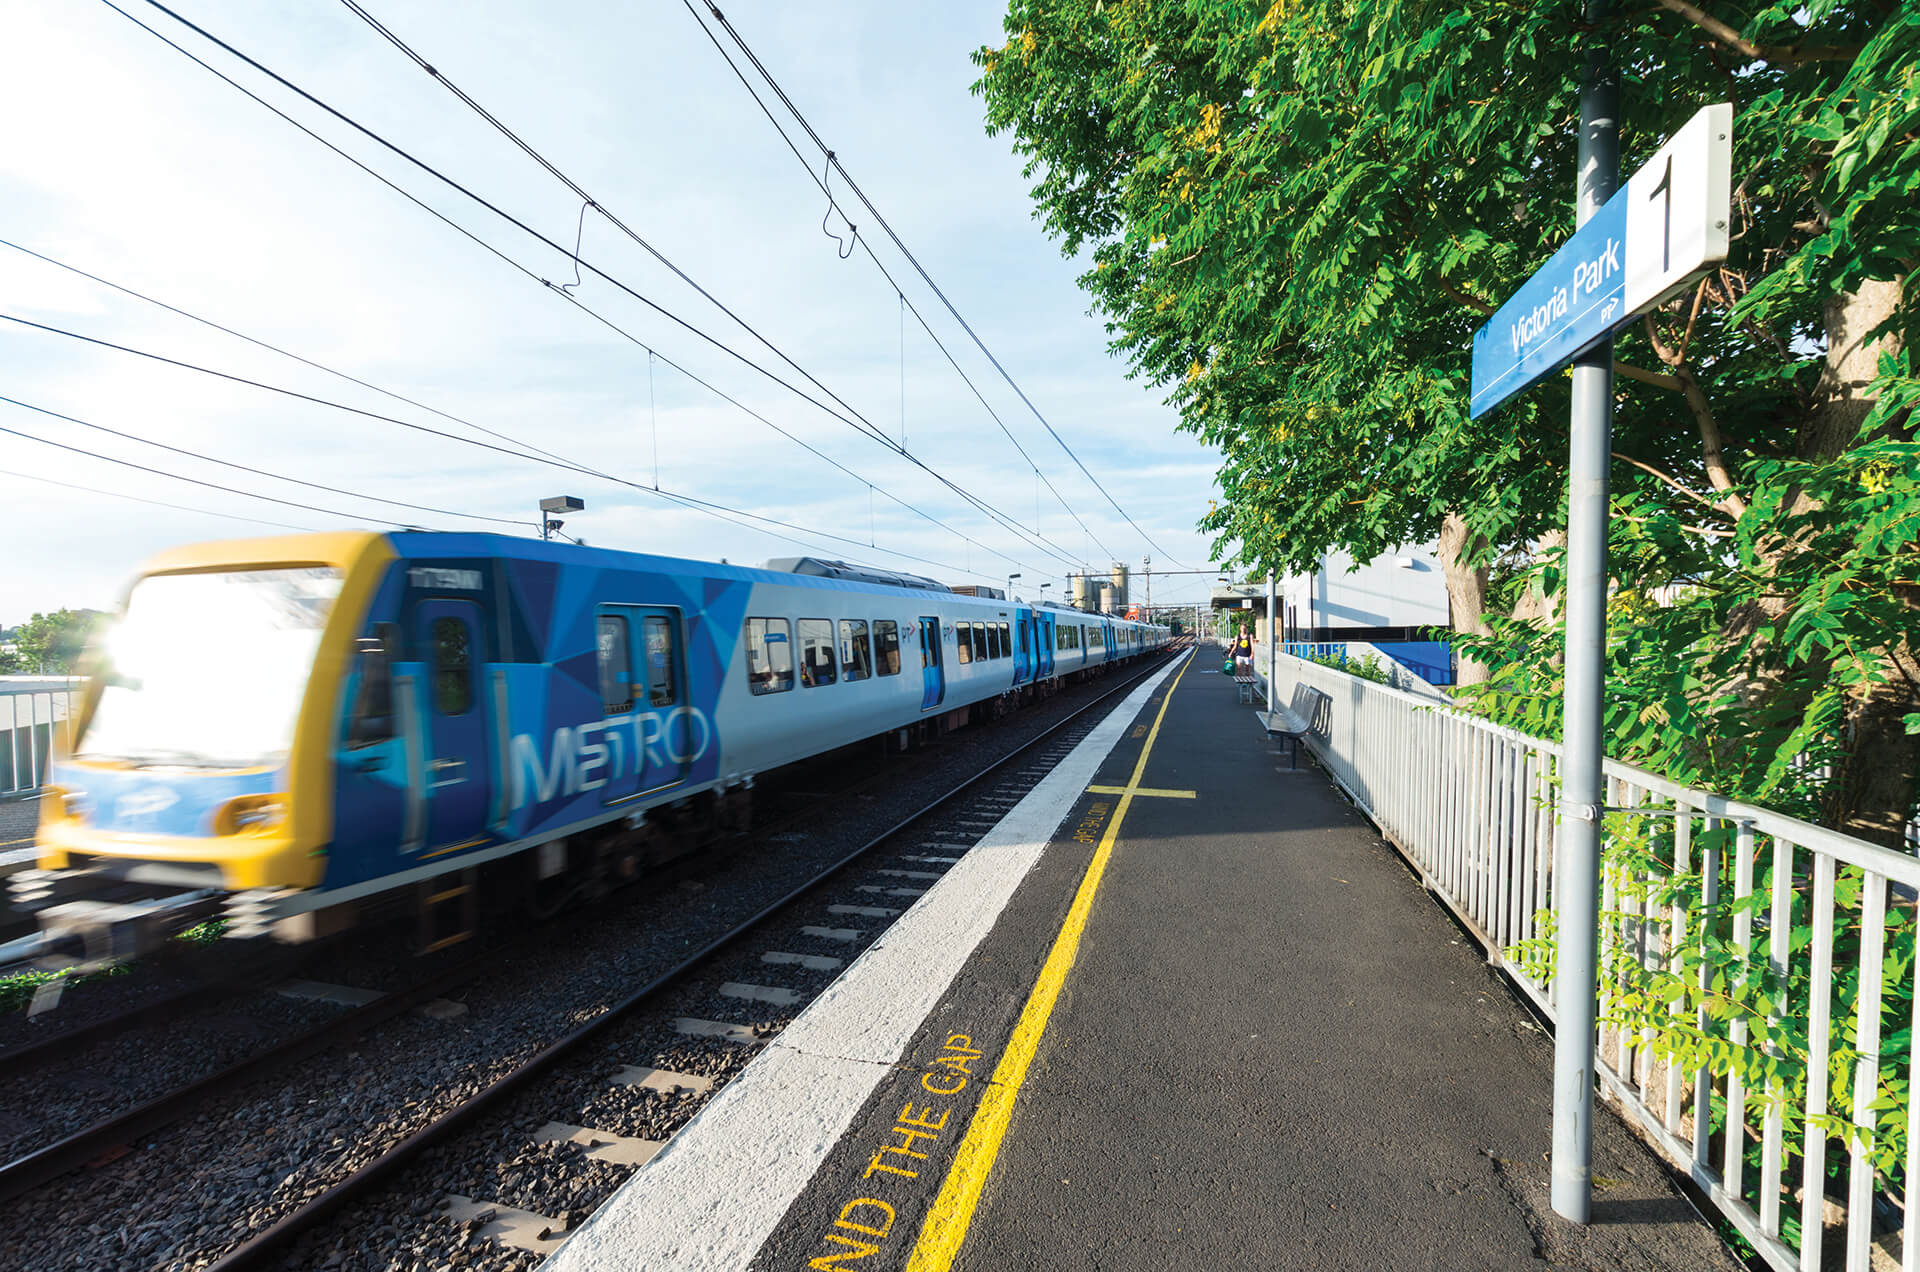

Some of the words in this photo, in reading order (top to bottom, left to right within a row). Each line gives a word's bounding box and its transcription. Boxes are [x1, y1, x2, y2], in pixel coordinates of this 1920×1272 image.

[1649, 153, 1673, 273] 1
[1511, 285, 1567, 352] Victoria
[1573, 237, 1620, 304] Park
[511, 706, 710, 811] METRO
[863, 1102, 952, 1178] THE
[922, 1032, 984, 1096] GAP
